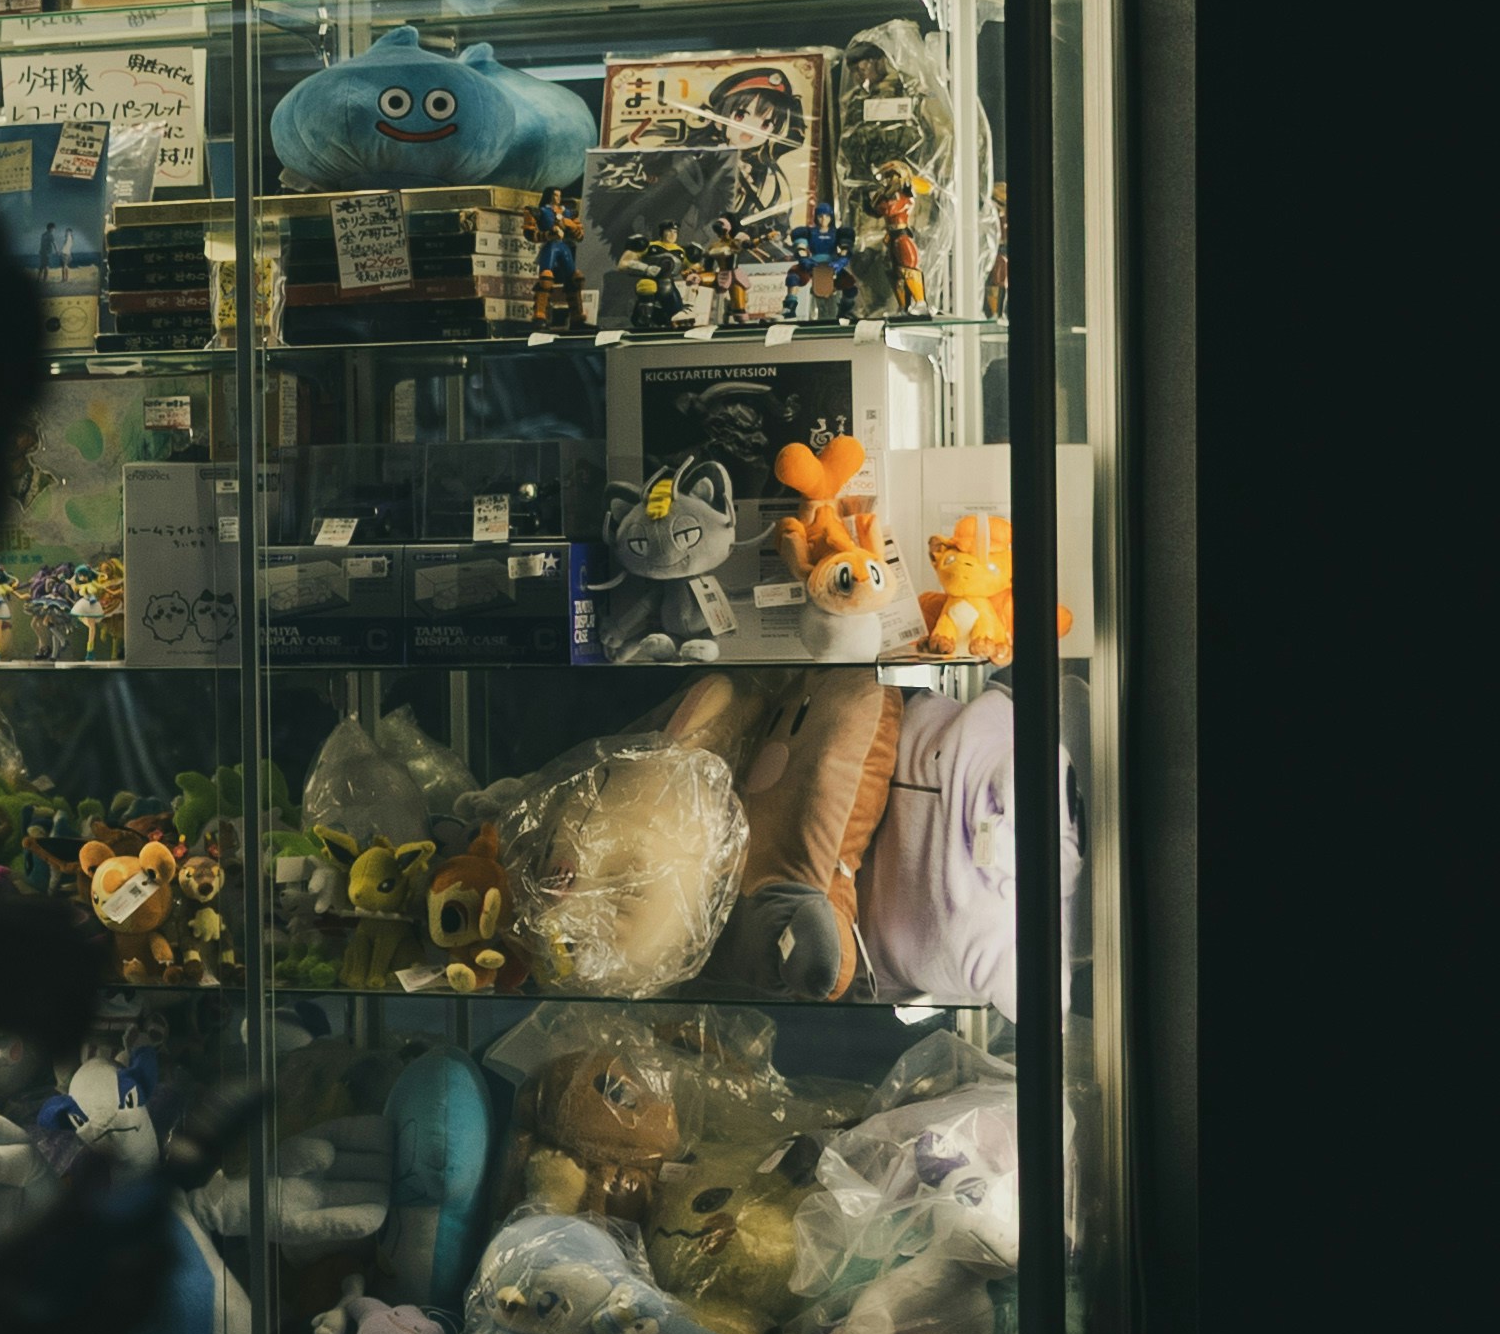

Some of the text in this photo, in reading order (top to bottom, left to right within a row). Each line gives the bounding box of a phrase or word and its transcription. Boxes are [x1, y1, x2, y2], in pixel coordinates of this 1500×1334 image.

[18, 64, 94, 96] 少年隊
[624, 77, 689, 109] まい
[644, 366, 778, 382] KICKSTARTER VERSION
[259, 626, 300, 637] AMIYA
[414, 625, 463, 636] TAMIYA
[259, 635, 342, 646] ISPLAY CASE
[414, 634, 509, 646] DISPLAY CASE
